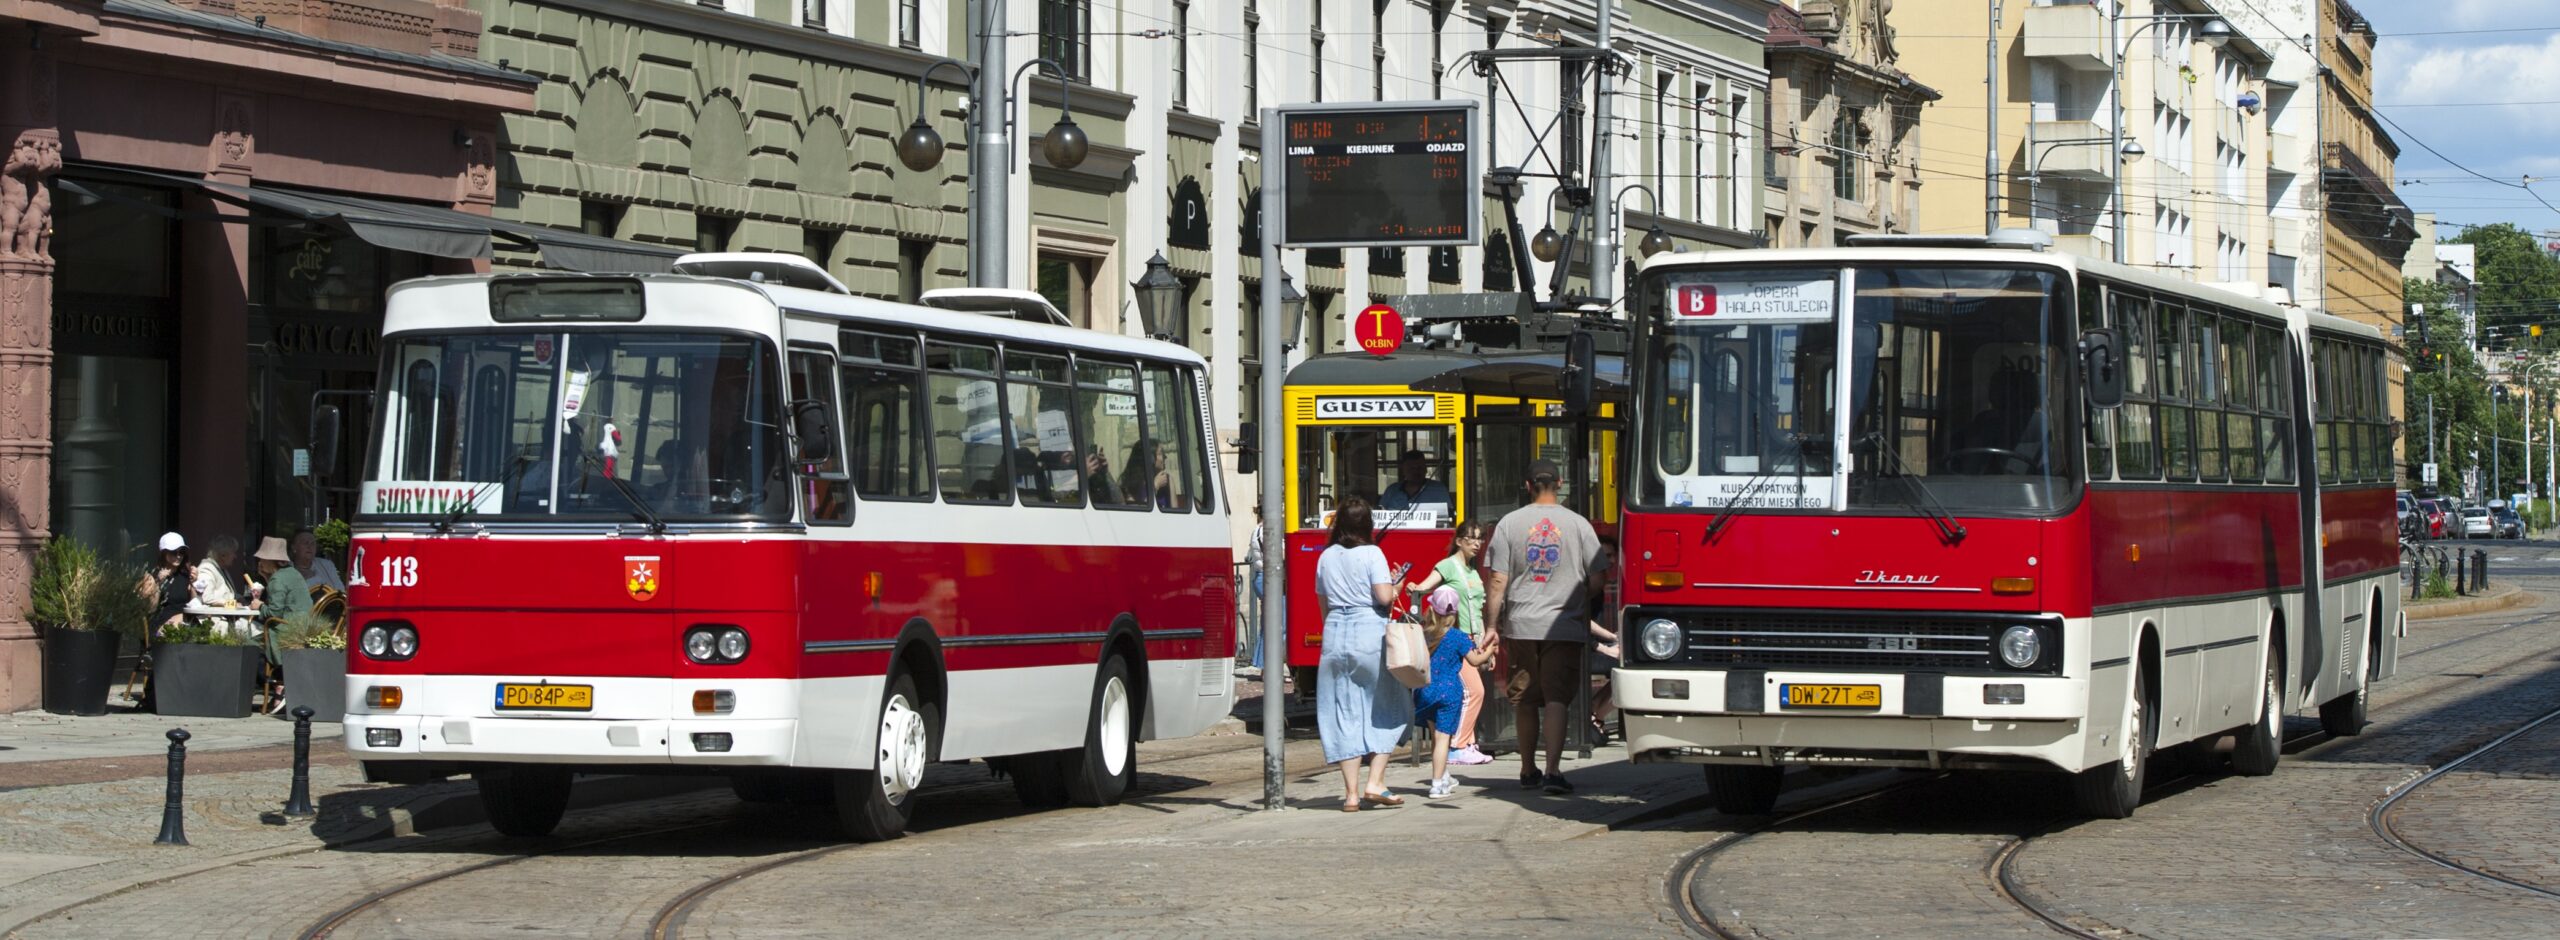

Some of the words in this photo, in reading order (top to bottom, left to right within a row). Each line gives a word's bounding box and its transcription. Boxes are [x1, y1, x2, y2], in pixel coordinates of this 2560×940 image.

[1288, 146, 1315, 155] LINIA
[1346, 144, 1395, 154] KIERUNEK
[1426, 143, 1466, 152] ODJAZD
[1187, 199, 1196, 230] P
[1754, 285, 1799, 298] OPERA
[1690, 288, 1705, 313] B
[1725, 300, 1761, 313] HALA
[1764, 299, 1828, 313] STULECIA
[1368, 310, 1390, 337] T
[279, 321, 378, 356] GRYCAN
[1322, 400, 1427, 413] GUSTAW
[1720, 483, 1744, 494] KLUB
[376, 487, 478, 514] SURVIVAL
[380, 555, 419, 588] 113
[1855, 570, 1940, 584] Ikarus
[533, 687, 565, 706] 84P
[1791, 686, 1814, 705] DW
[1820, 686, 1852, 705] 27T
